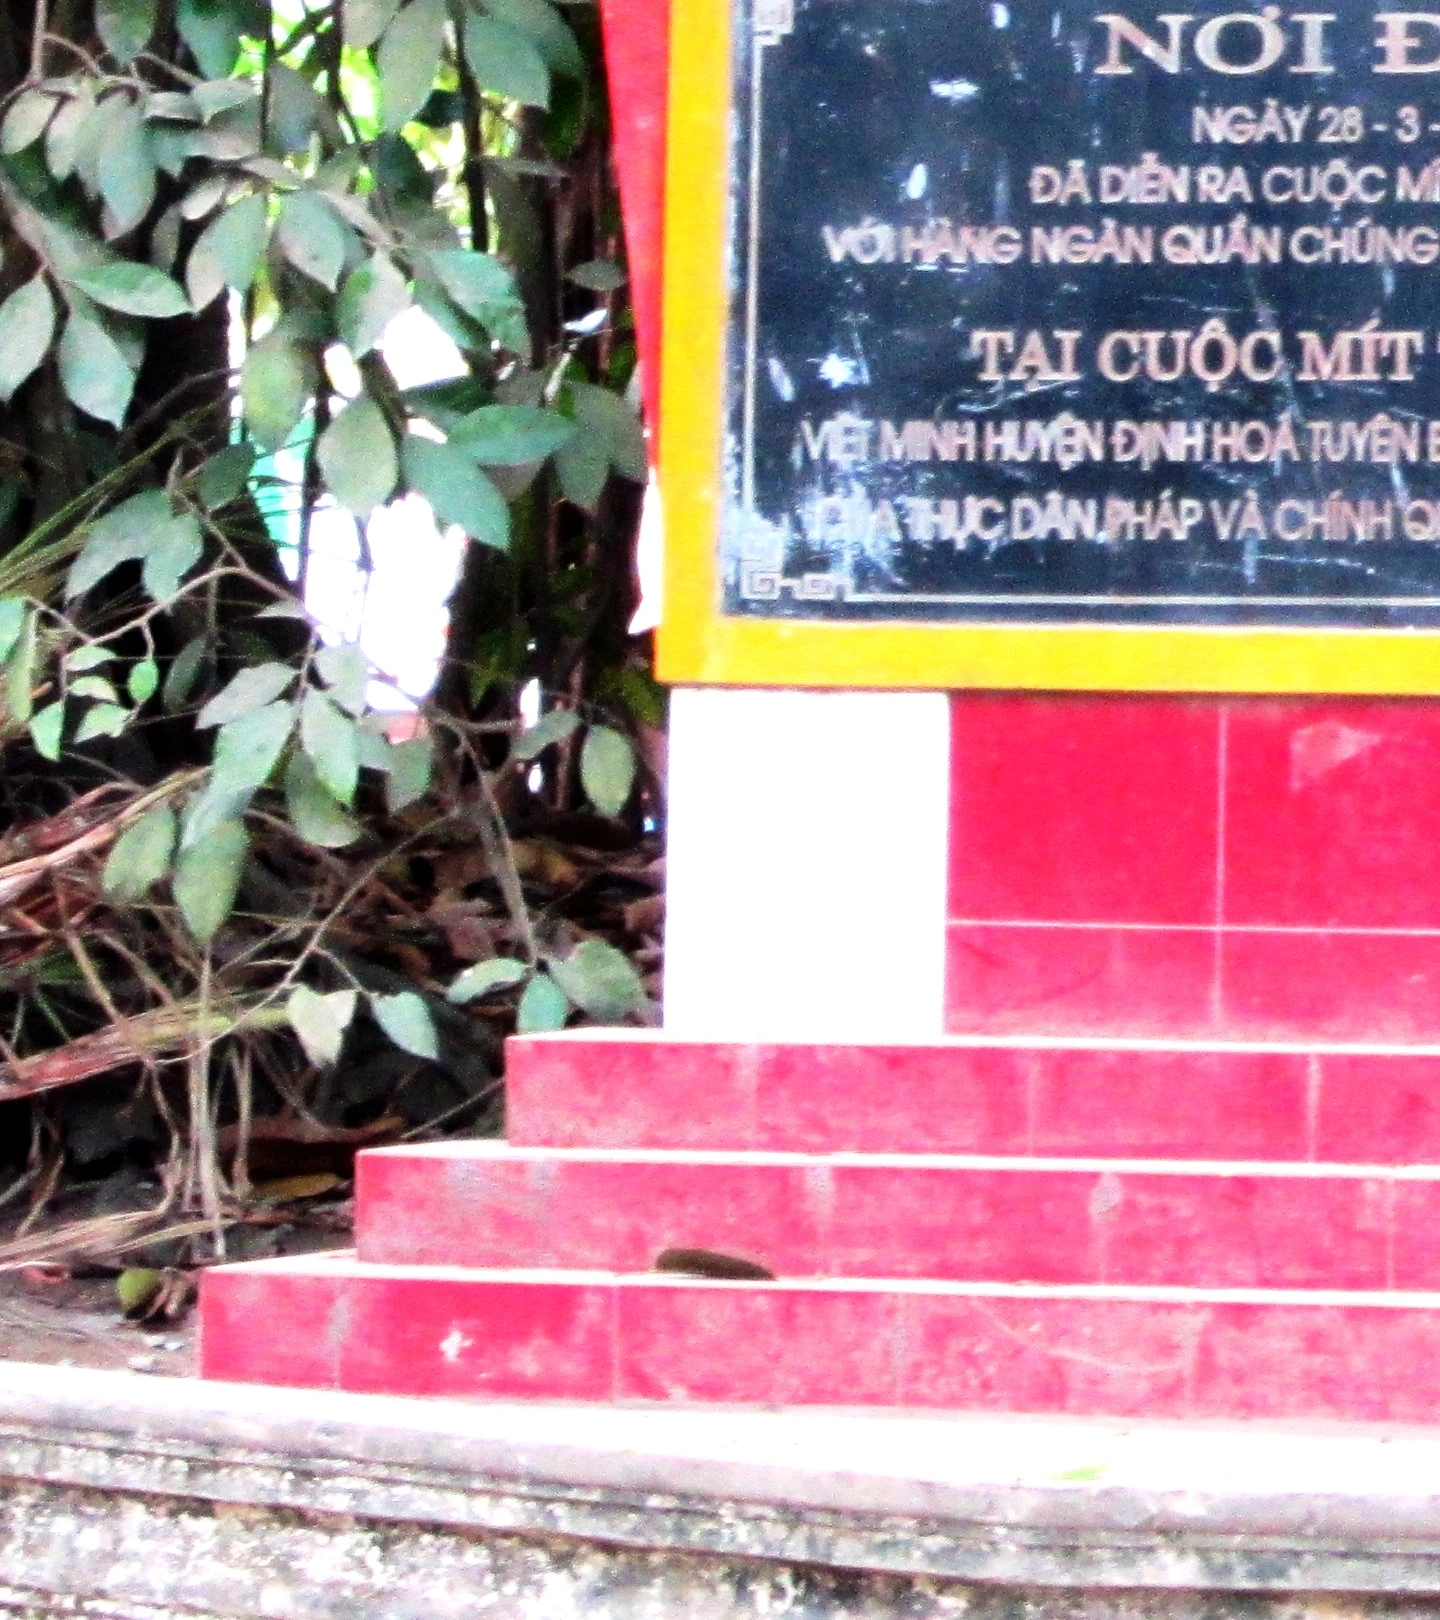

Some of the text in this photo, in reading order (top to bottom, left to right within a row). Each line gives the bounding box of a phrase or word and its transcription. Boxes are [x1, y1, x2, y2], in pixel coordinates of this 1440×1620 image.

[1094, 5, 1337, 74] NƠI
[1192, 98, 1309, 143] NGÀY
[1318, 106, 1364, 143] 28
[1397, 106, 1421, 143] 3
[1028, 159, 1092, 204] ĐÃ
[1198, 166, 1253, 203] RA
[1262, 159, 1387, 212] CUỘC
[1030, 216, 1155, 264] NGÀN
[1289, 218, 1439, 264] CHÚNG
[970, 330, 1083, 390] TẠI
[1100, 318, 1282, 391] CUỘC
[1298, 316, 1423, 381] MÍT
[880, 420, 975, 461] MINH
[985, 412, 1102, 469] HUYỆN
[1110, 420, 1204, 469] ĐỊNH
[1212, 411, 1299, 461] HOÁ
[1305, 414, 1419, 462] TUYÊN
[904, 495, 1004, 550] THỰC
[1012, 491, 1098, 540] DÂN
[1103, 488, 1202, 540] PHÁP
[1210, 489, 1267, 540] VÀ
[1273, 490, 1394, 541] CHÍNH
